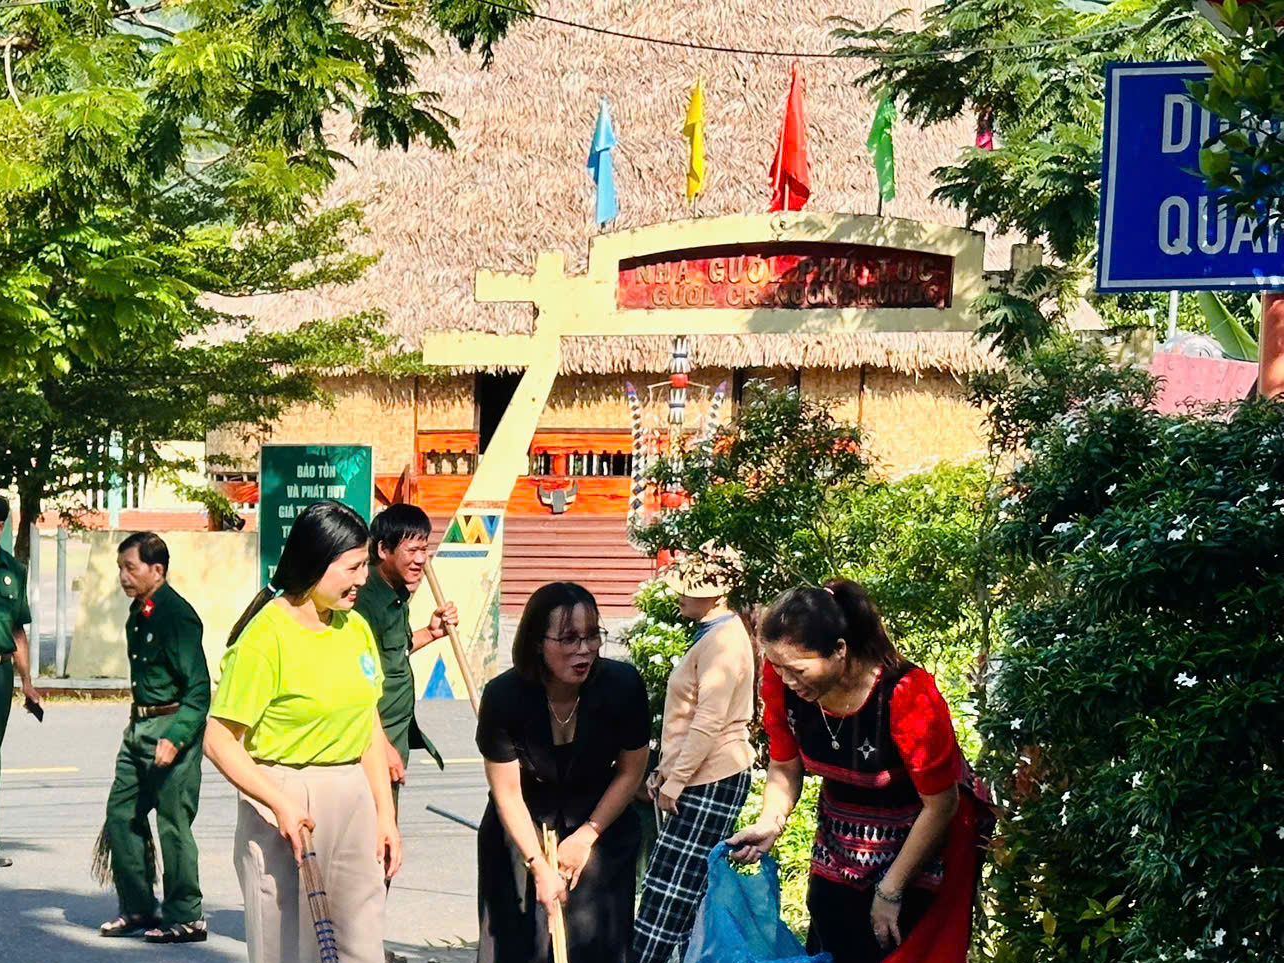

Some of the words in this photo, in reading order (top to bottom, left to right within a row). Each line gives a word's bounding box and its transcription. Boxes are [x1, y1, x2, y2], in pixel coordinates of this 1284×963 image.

[297, 462, 316, 479] BẢO
[318, 461, 336, 479] TỒN
[287, 483, 299, 499] VÀ
[301, 484, 324, 499] PHÁT
[327, 485, 347, 499] HUY
[278, 503, 295, 518] GIÁ
